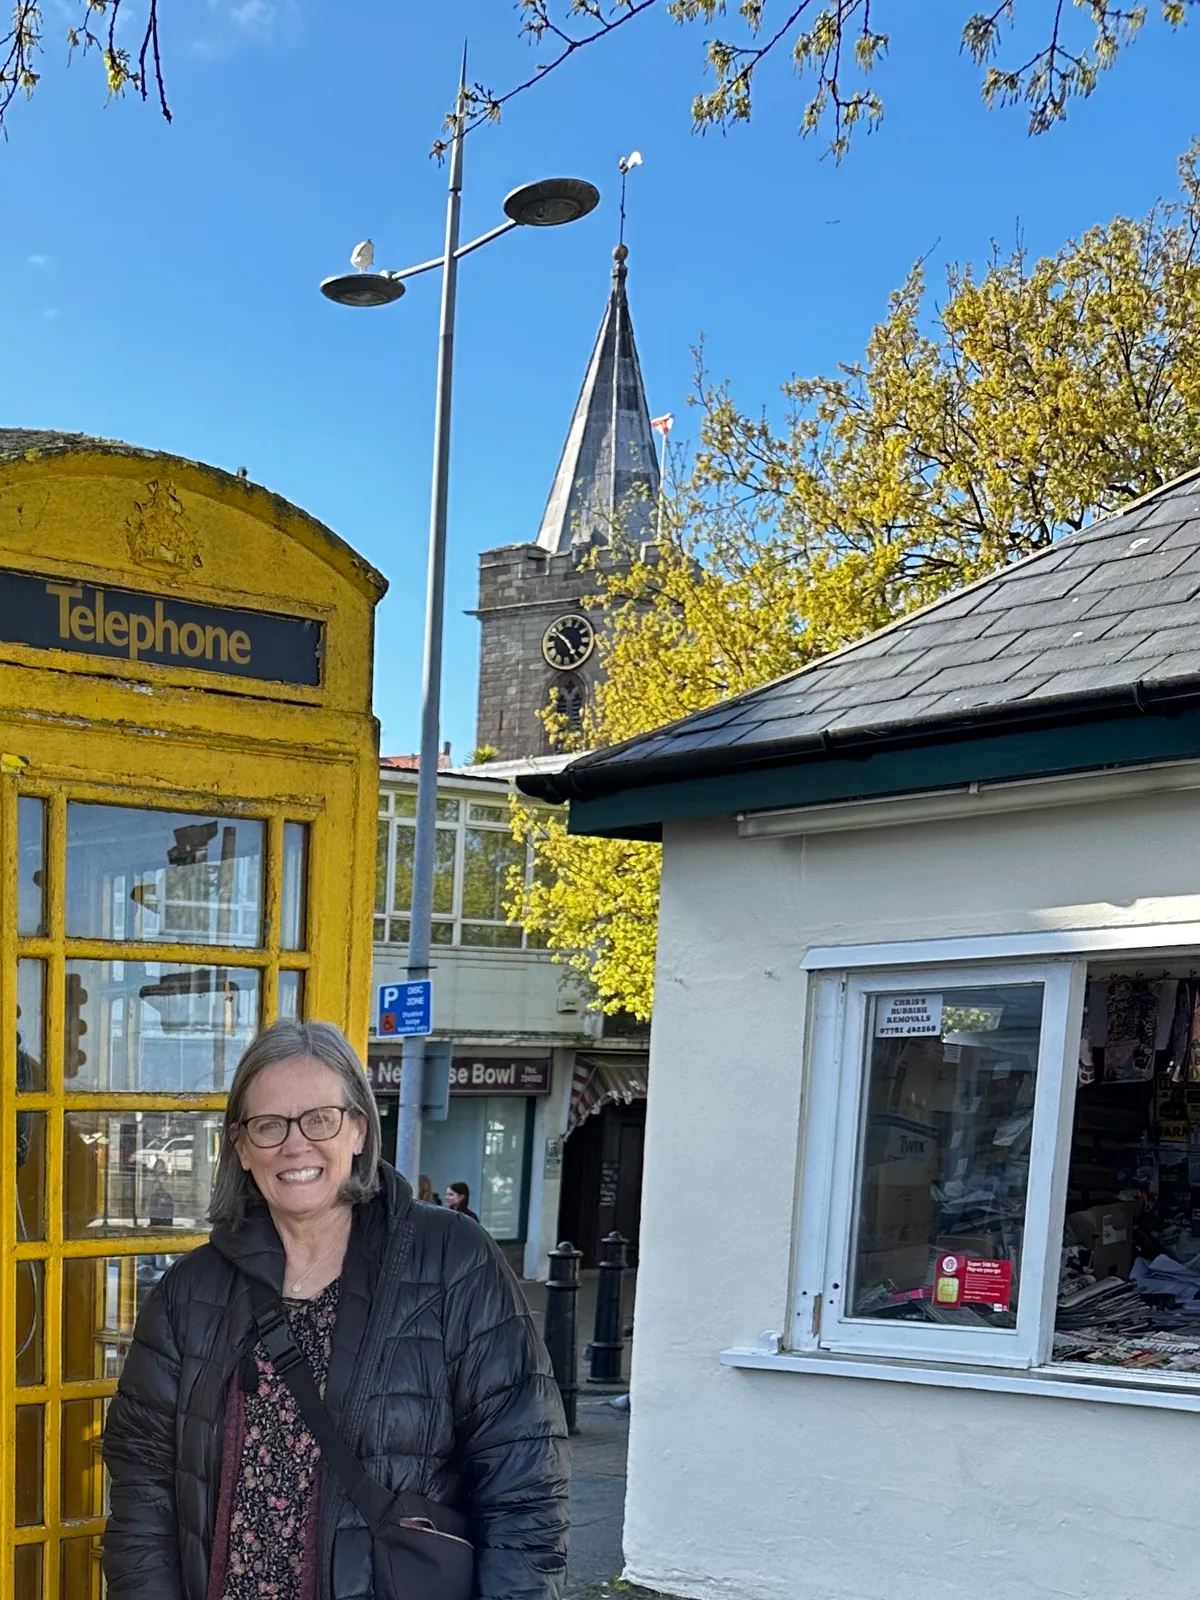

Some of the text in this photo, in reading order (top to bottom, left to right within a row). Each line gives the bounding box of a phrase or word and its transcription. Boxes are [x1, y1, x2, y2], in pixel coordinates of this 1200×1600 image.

[46, 584, 251, 665] Telephone
[407, 986, 424, 995] DISC
[383, 987, 399, 1009] P
[406, 997, 424, 1006] ZONE
[894, 998, 926, 1006] CHRIS'S
[887, 1015, 931, 1023] REMOVALS
[472, 1063, 515, 1085] Bowl
